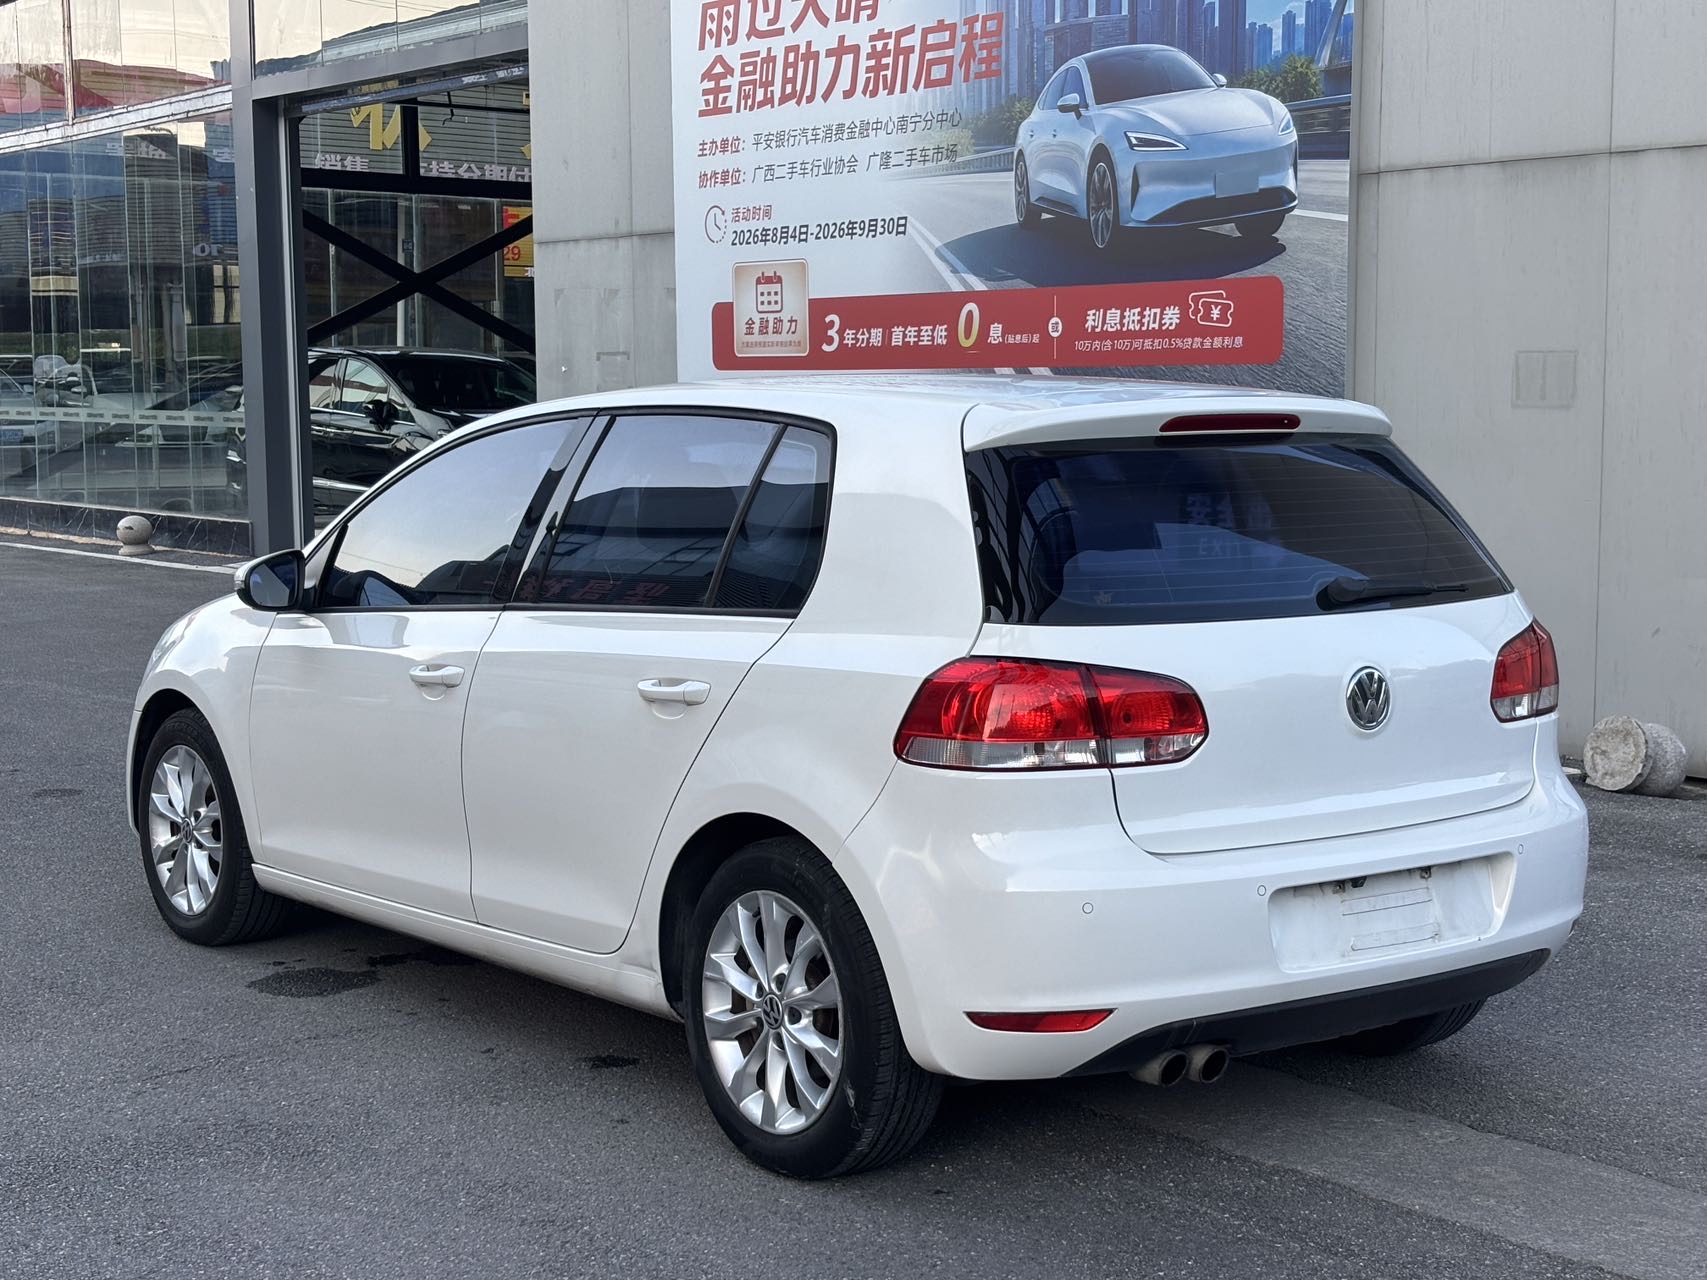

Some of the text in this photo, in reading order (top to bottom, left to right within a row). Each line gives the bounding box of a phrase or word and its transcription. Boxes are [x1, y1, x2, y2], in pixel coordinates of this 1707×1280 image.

[698, 12, 1005, 118] 金融助力新启程
[731, 204, 773, 223] 活动时间
[731, 215, 908, 247] 2026年8月4日-2026年9月30日
[744, 316, 798, 336] 金融助力
[1085, 305, 1181, 333] 利息抵扣券
